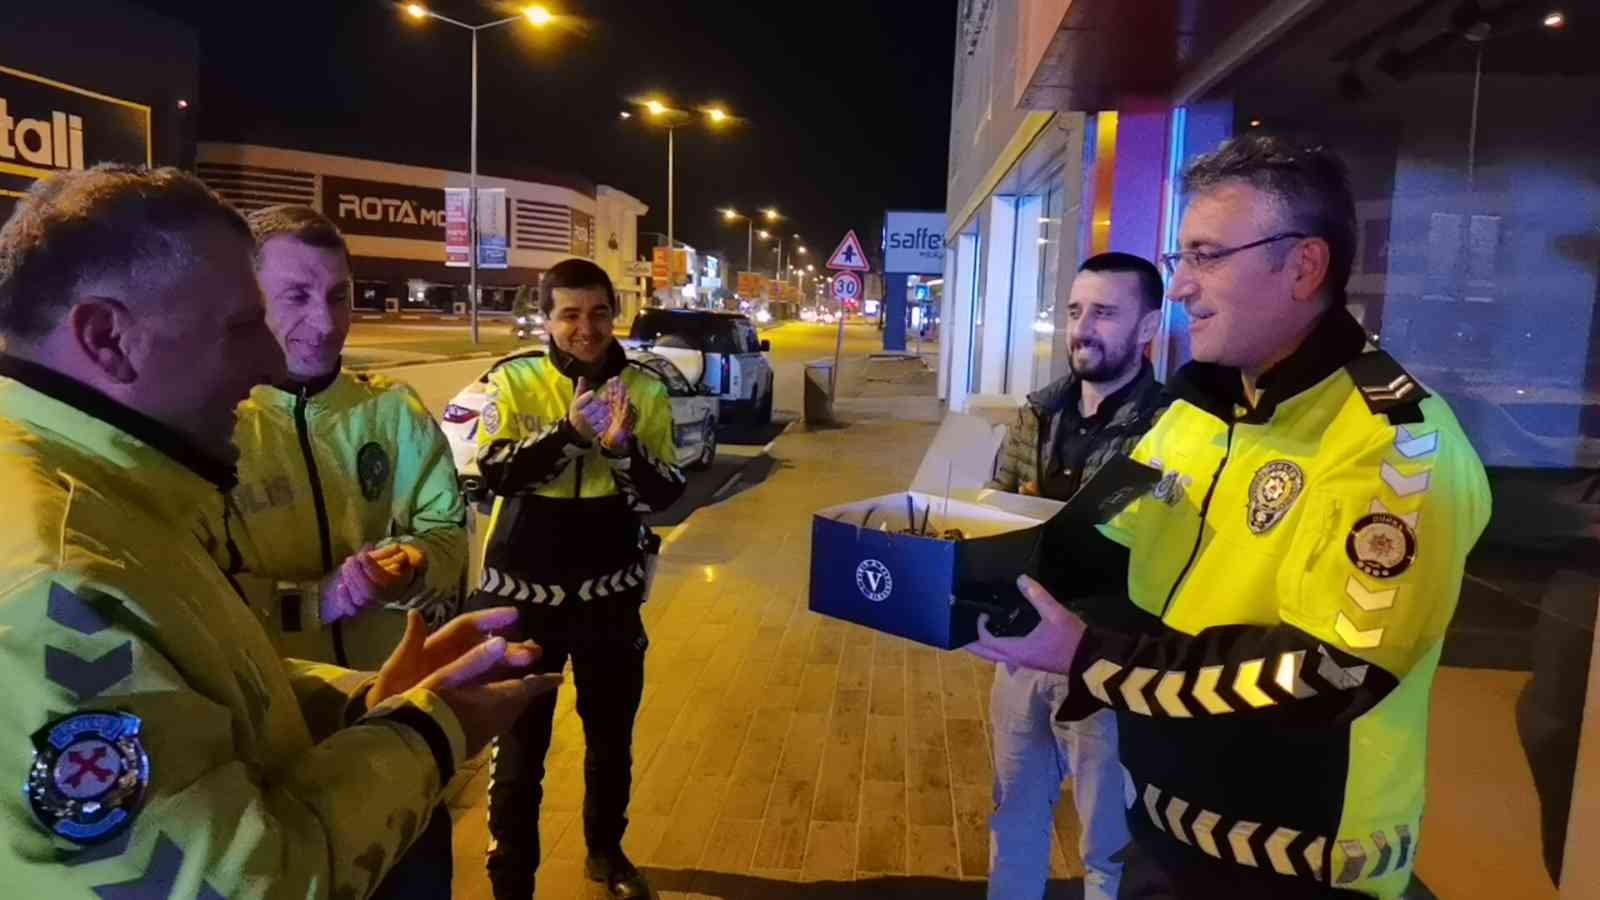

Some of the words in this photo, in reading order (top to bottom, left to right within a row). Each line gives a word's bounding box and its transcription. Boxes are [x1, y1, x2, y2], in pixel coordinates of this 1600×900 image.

[338, 193, 418, 225] ROTA
[890, 228, 947, 250] saffe
[836, 279, 855, 295] 30
[864, 570, 882, 592] V
